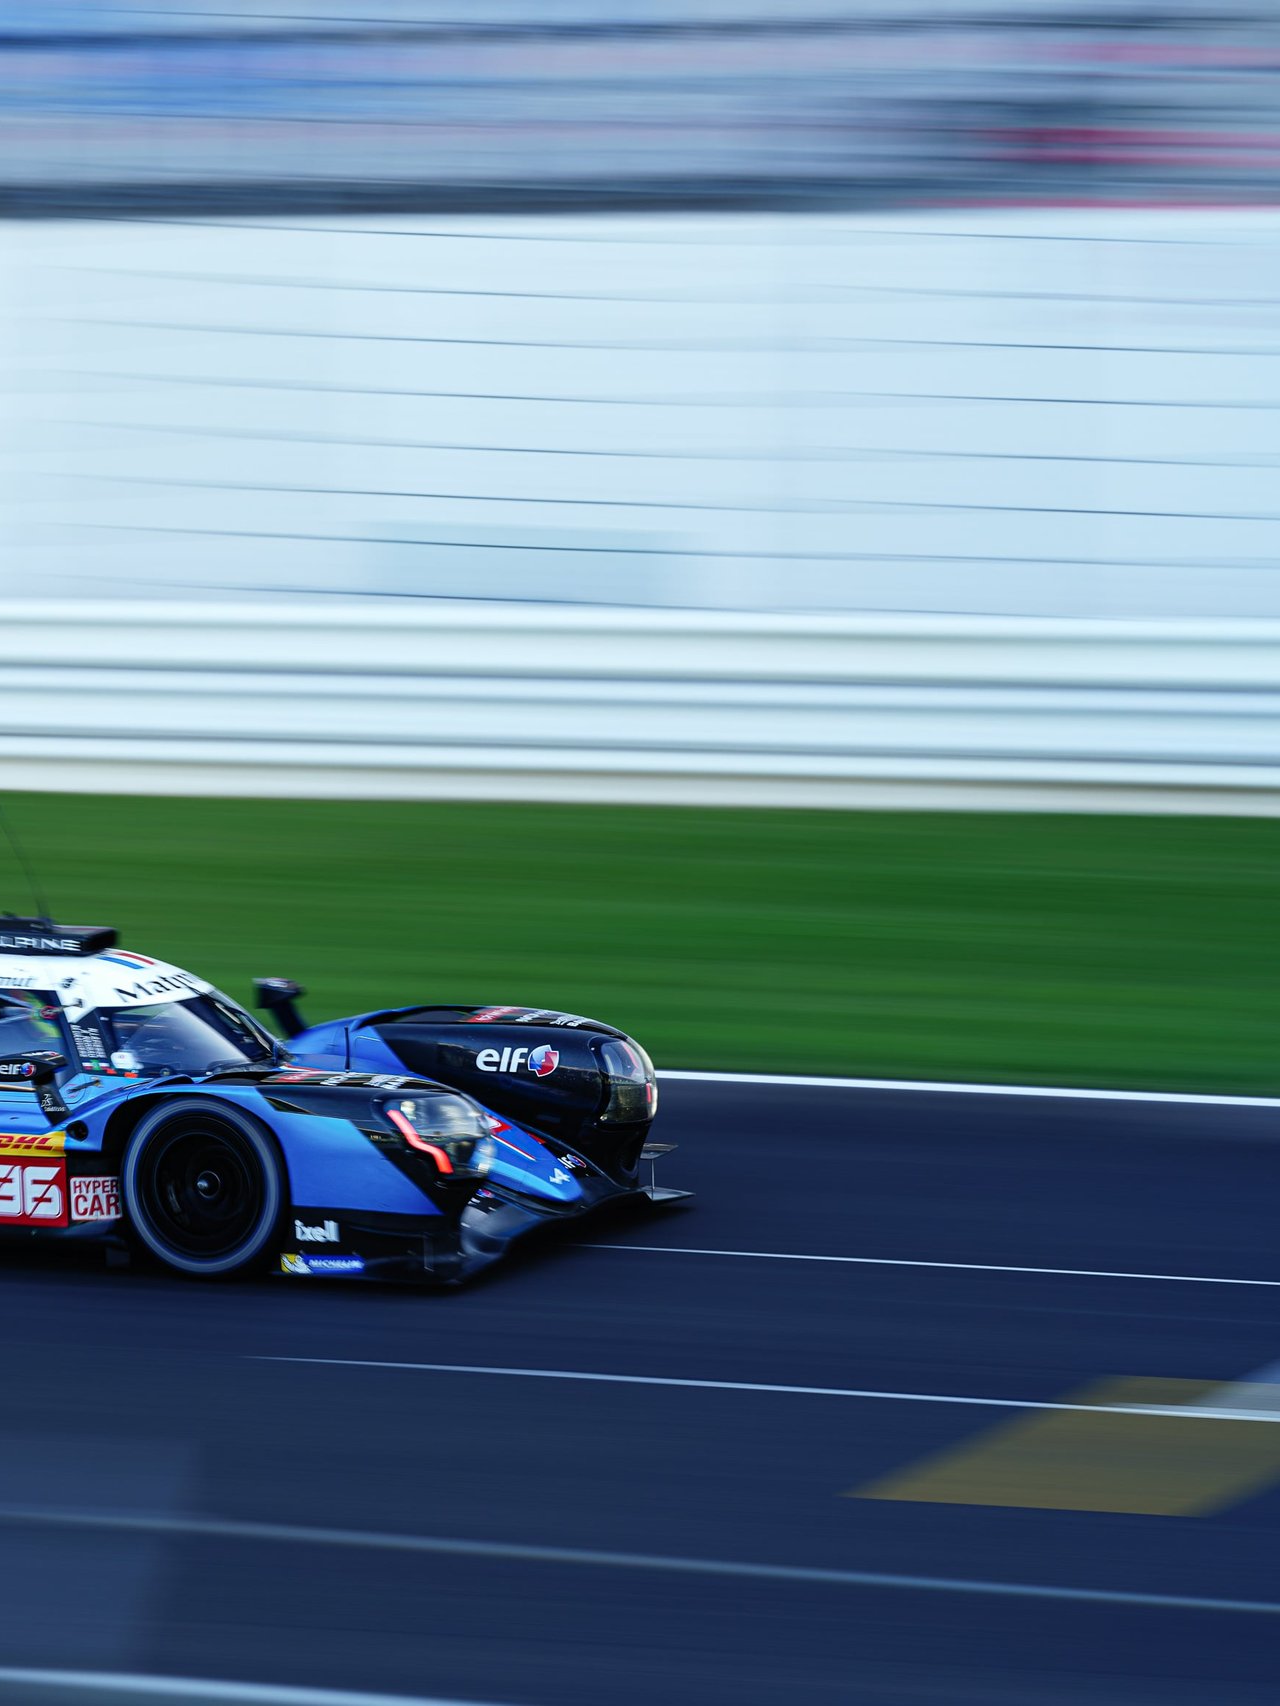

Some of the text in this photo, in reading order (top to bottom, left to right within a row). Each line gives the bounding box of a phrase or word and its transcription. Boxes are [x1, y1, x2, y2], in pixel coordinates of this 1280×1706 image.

[476, 1047, 529, 1073] elf
[73, 1179, 120, 1194] HYPER
[74, 1193, 121, 1216] CAR
[294, 1219, 340, 1243] ixell
